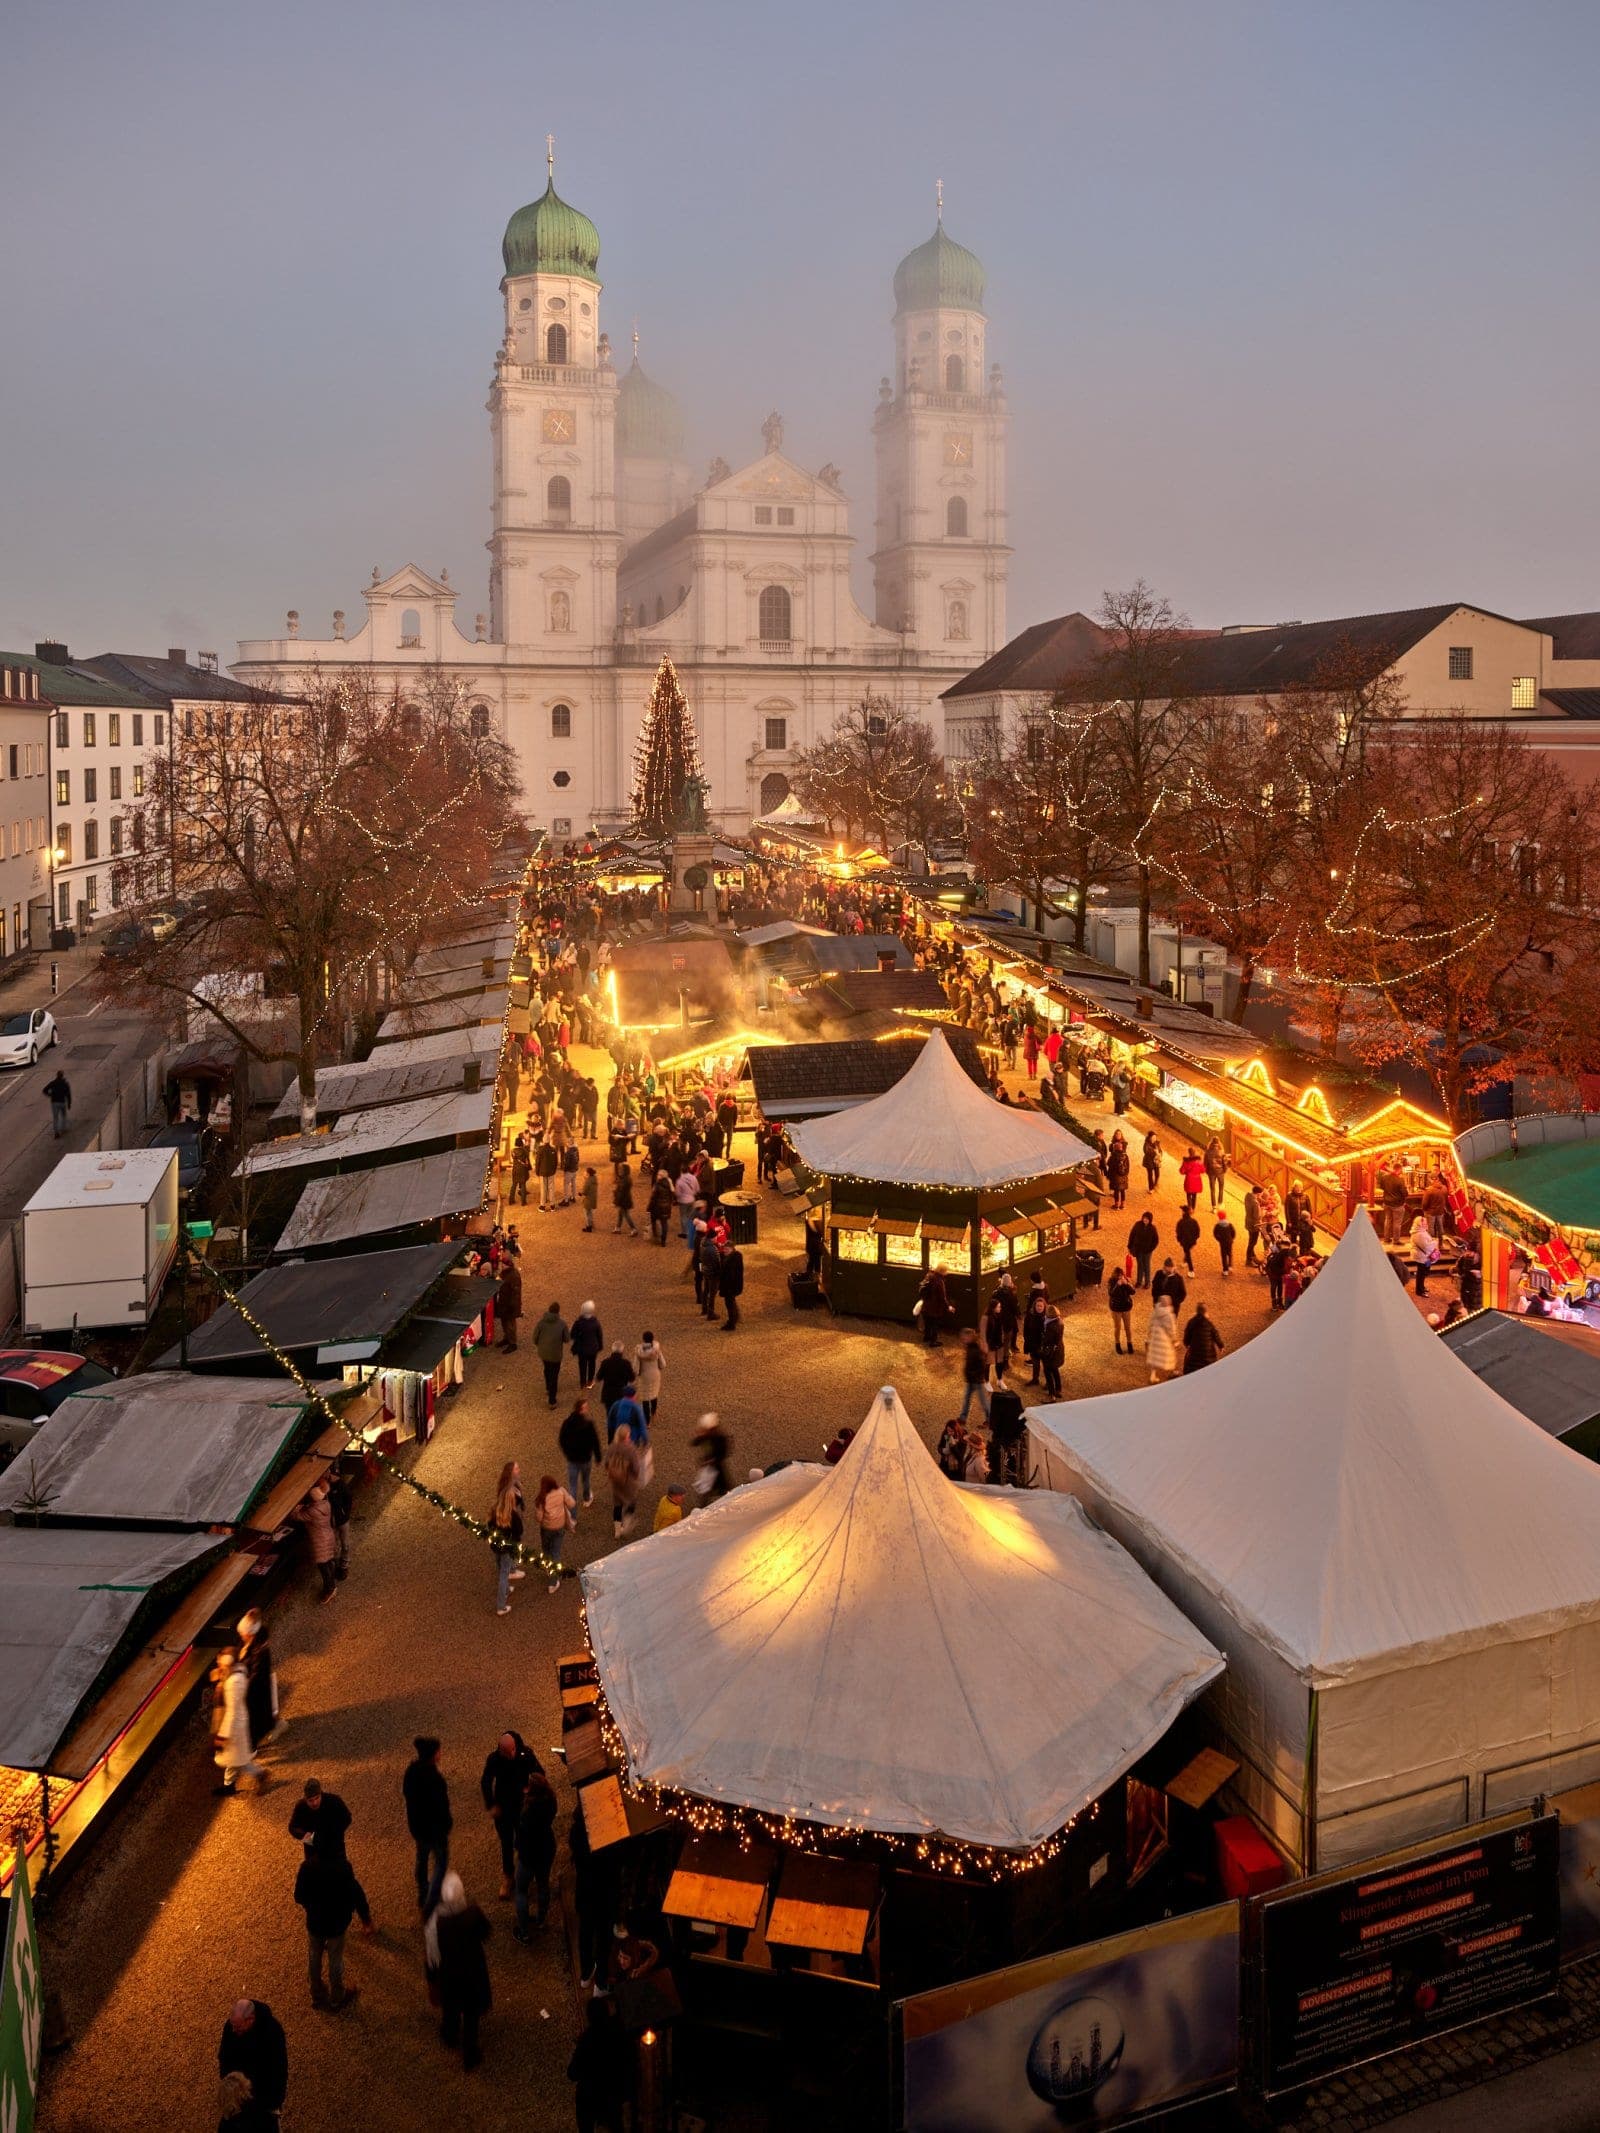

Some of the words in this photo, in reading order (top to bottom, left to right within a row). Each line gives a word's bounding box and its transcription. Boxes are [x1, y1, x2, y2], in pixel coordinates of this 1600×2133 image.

[1340, 1890, 1401, 1926] Klingender
[1406, 1877, 1441, 1903] Advent
[1445, 1872, 1460, 1890] im
[1462, 1862, 1488, 1884] Dom
[1360, 1892, 1473, 1939] MITTAGSORGELKONZERTE
[1461, 1926, 1518, 1954] DOMKONZERT
[1301, 1971, 1389, 2009] ADVENTSANSINGEN
